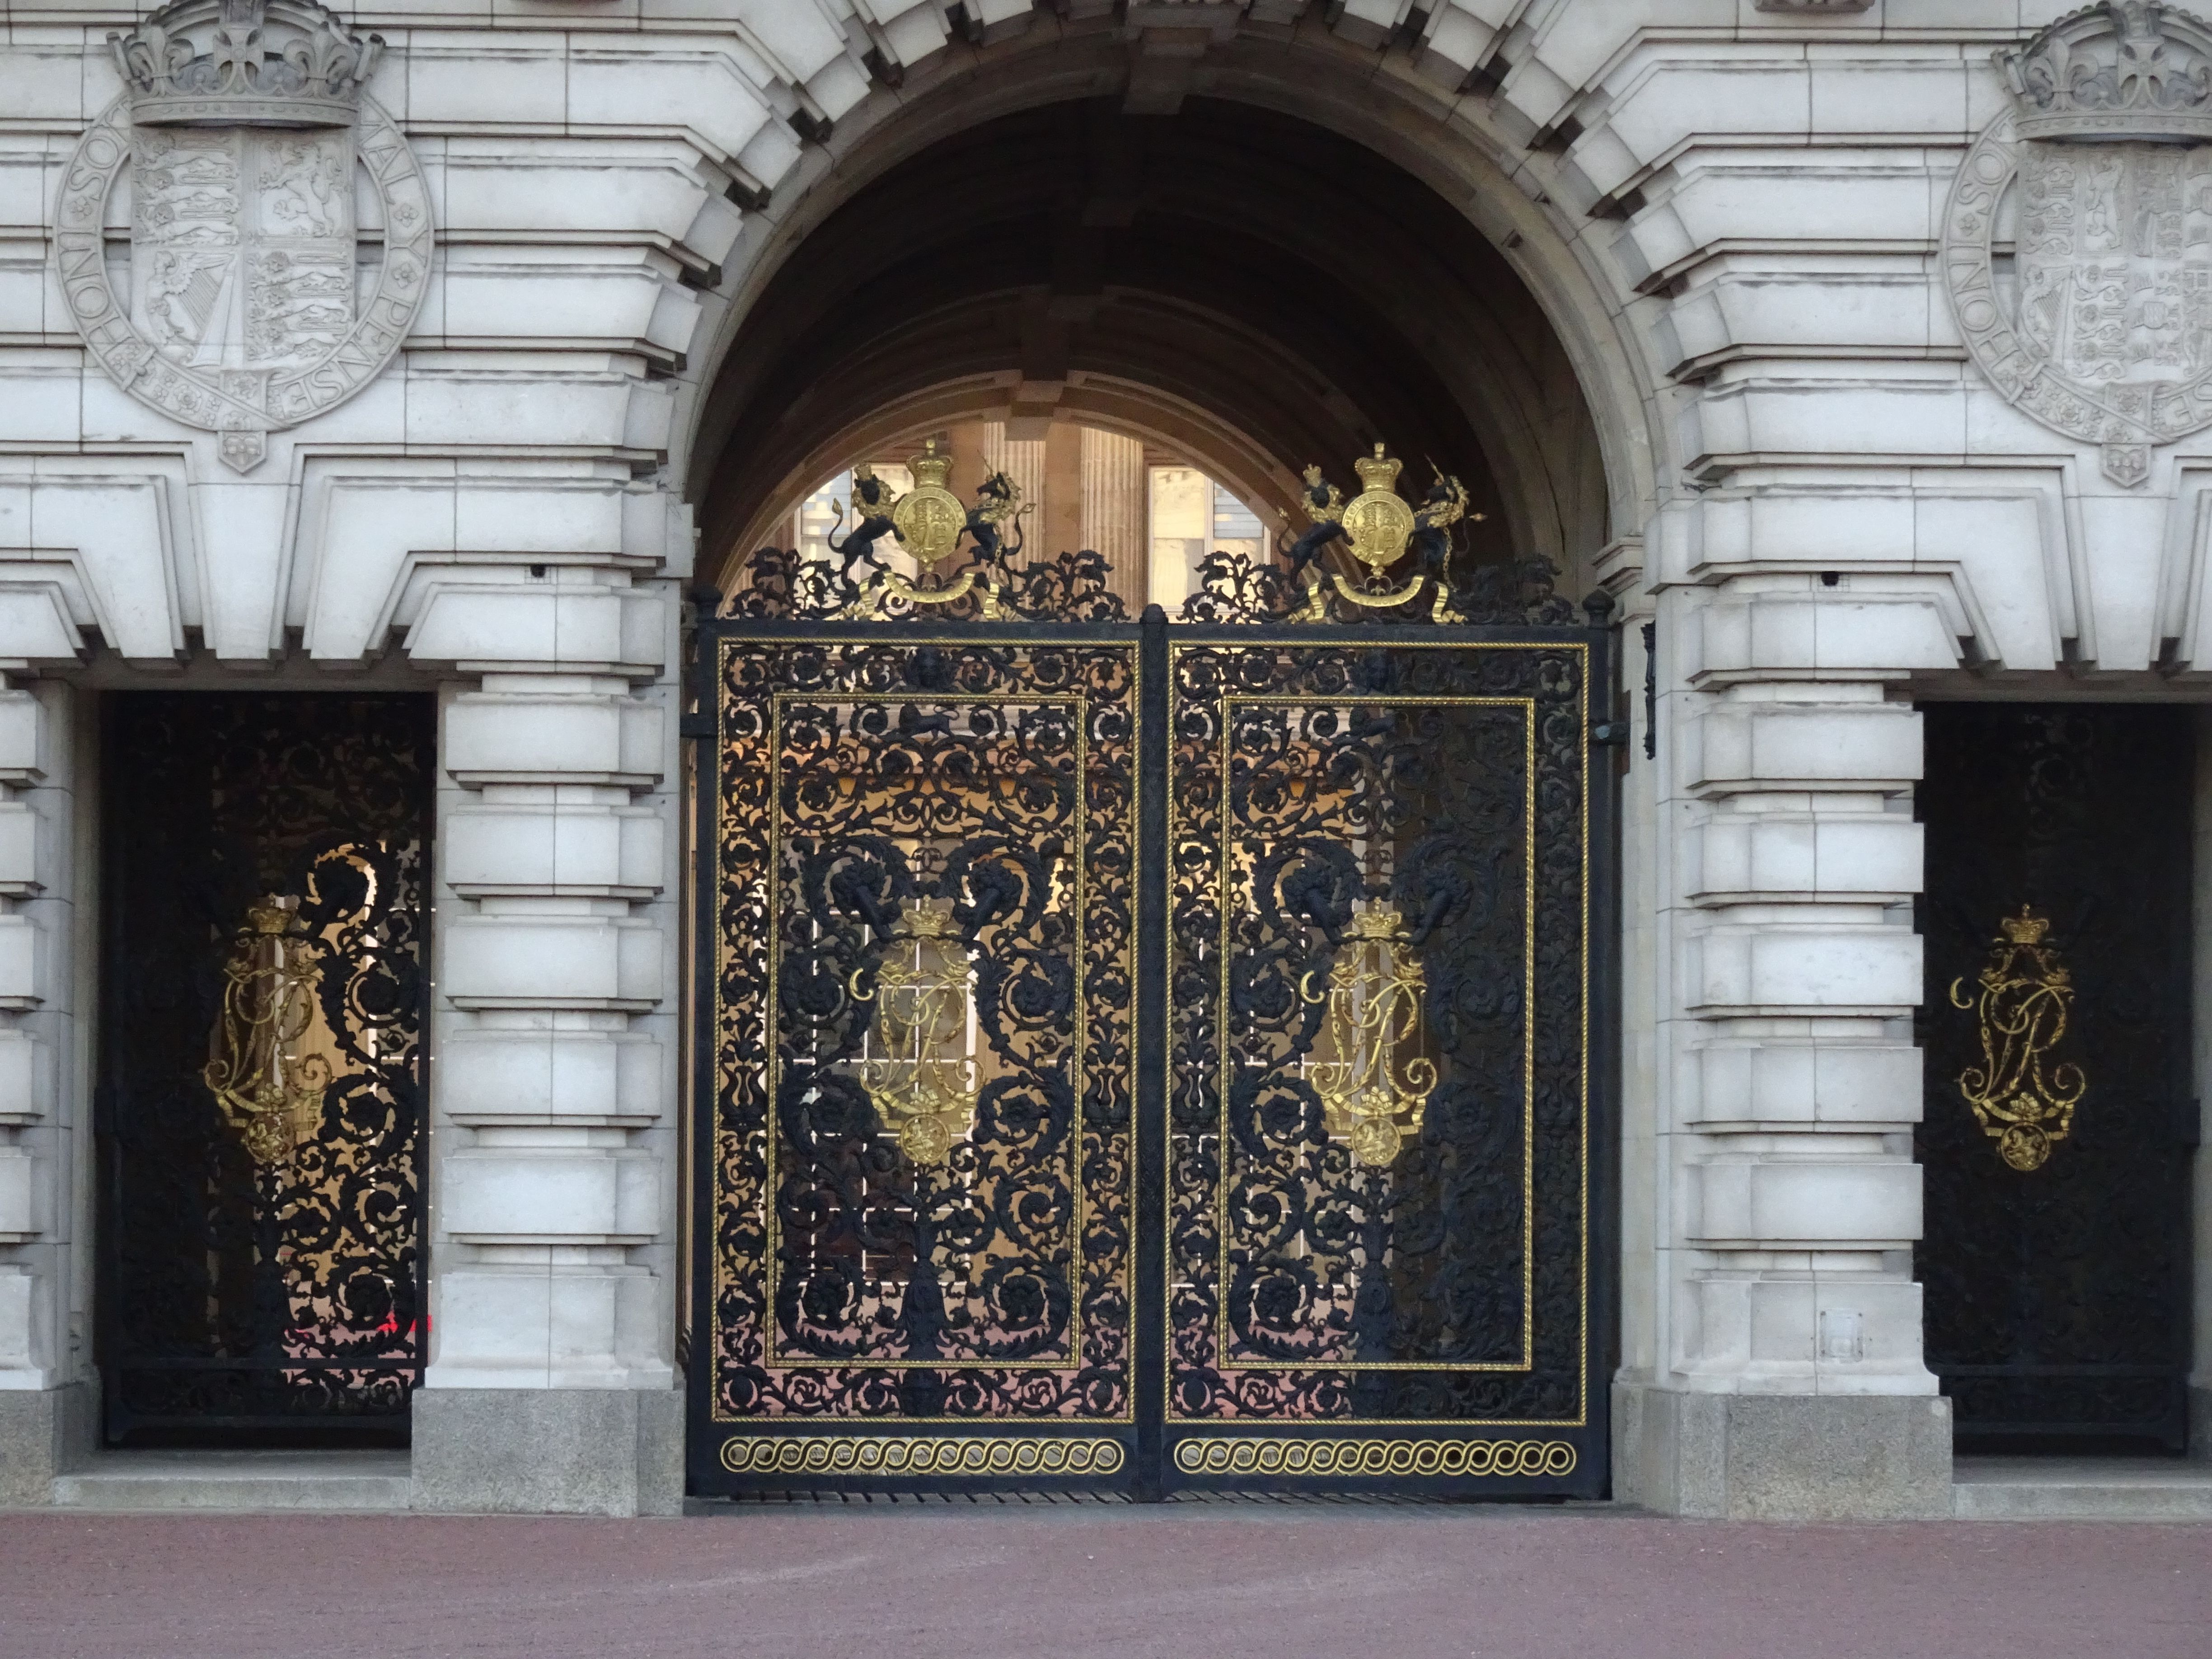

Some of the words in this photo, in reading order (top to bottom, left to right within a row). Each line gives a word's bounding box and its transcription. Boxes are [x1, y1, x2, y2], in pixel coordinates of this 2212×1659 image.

[58, 225, 135, 359] HONI
[389, 223, 428, 267] Y
[1947, 240, 2021, 370] HONI
[282, 291, 416, 419] PENSE
